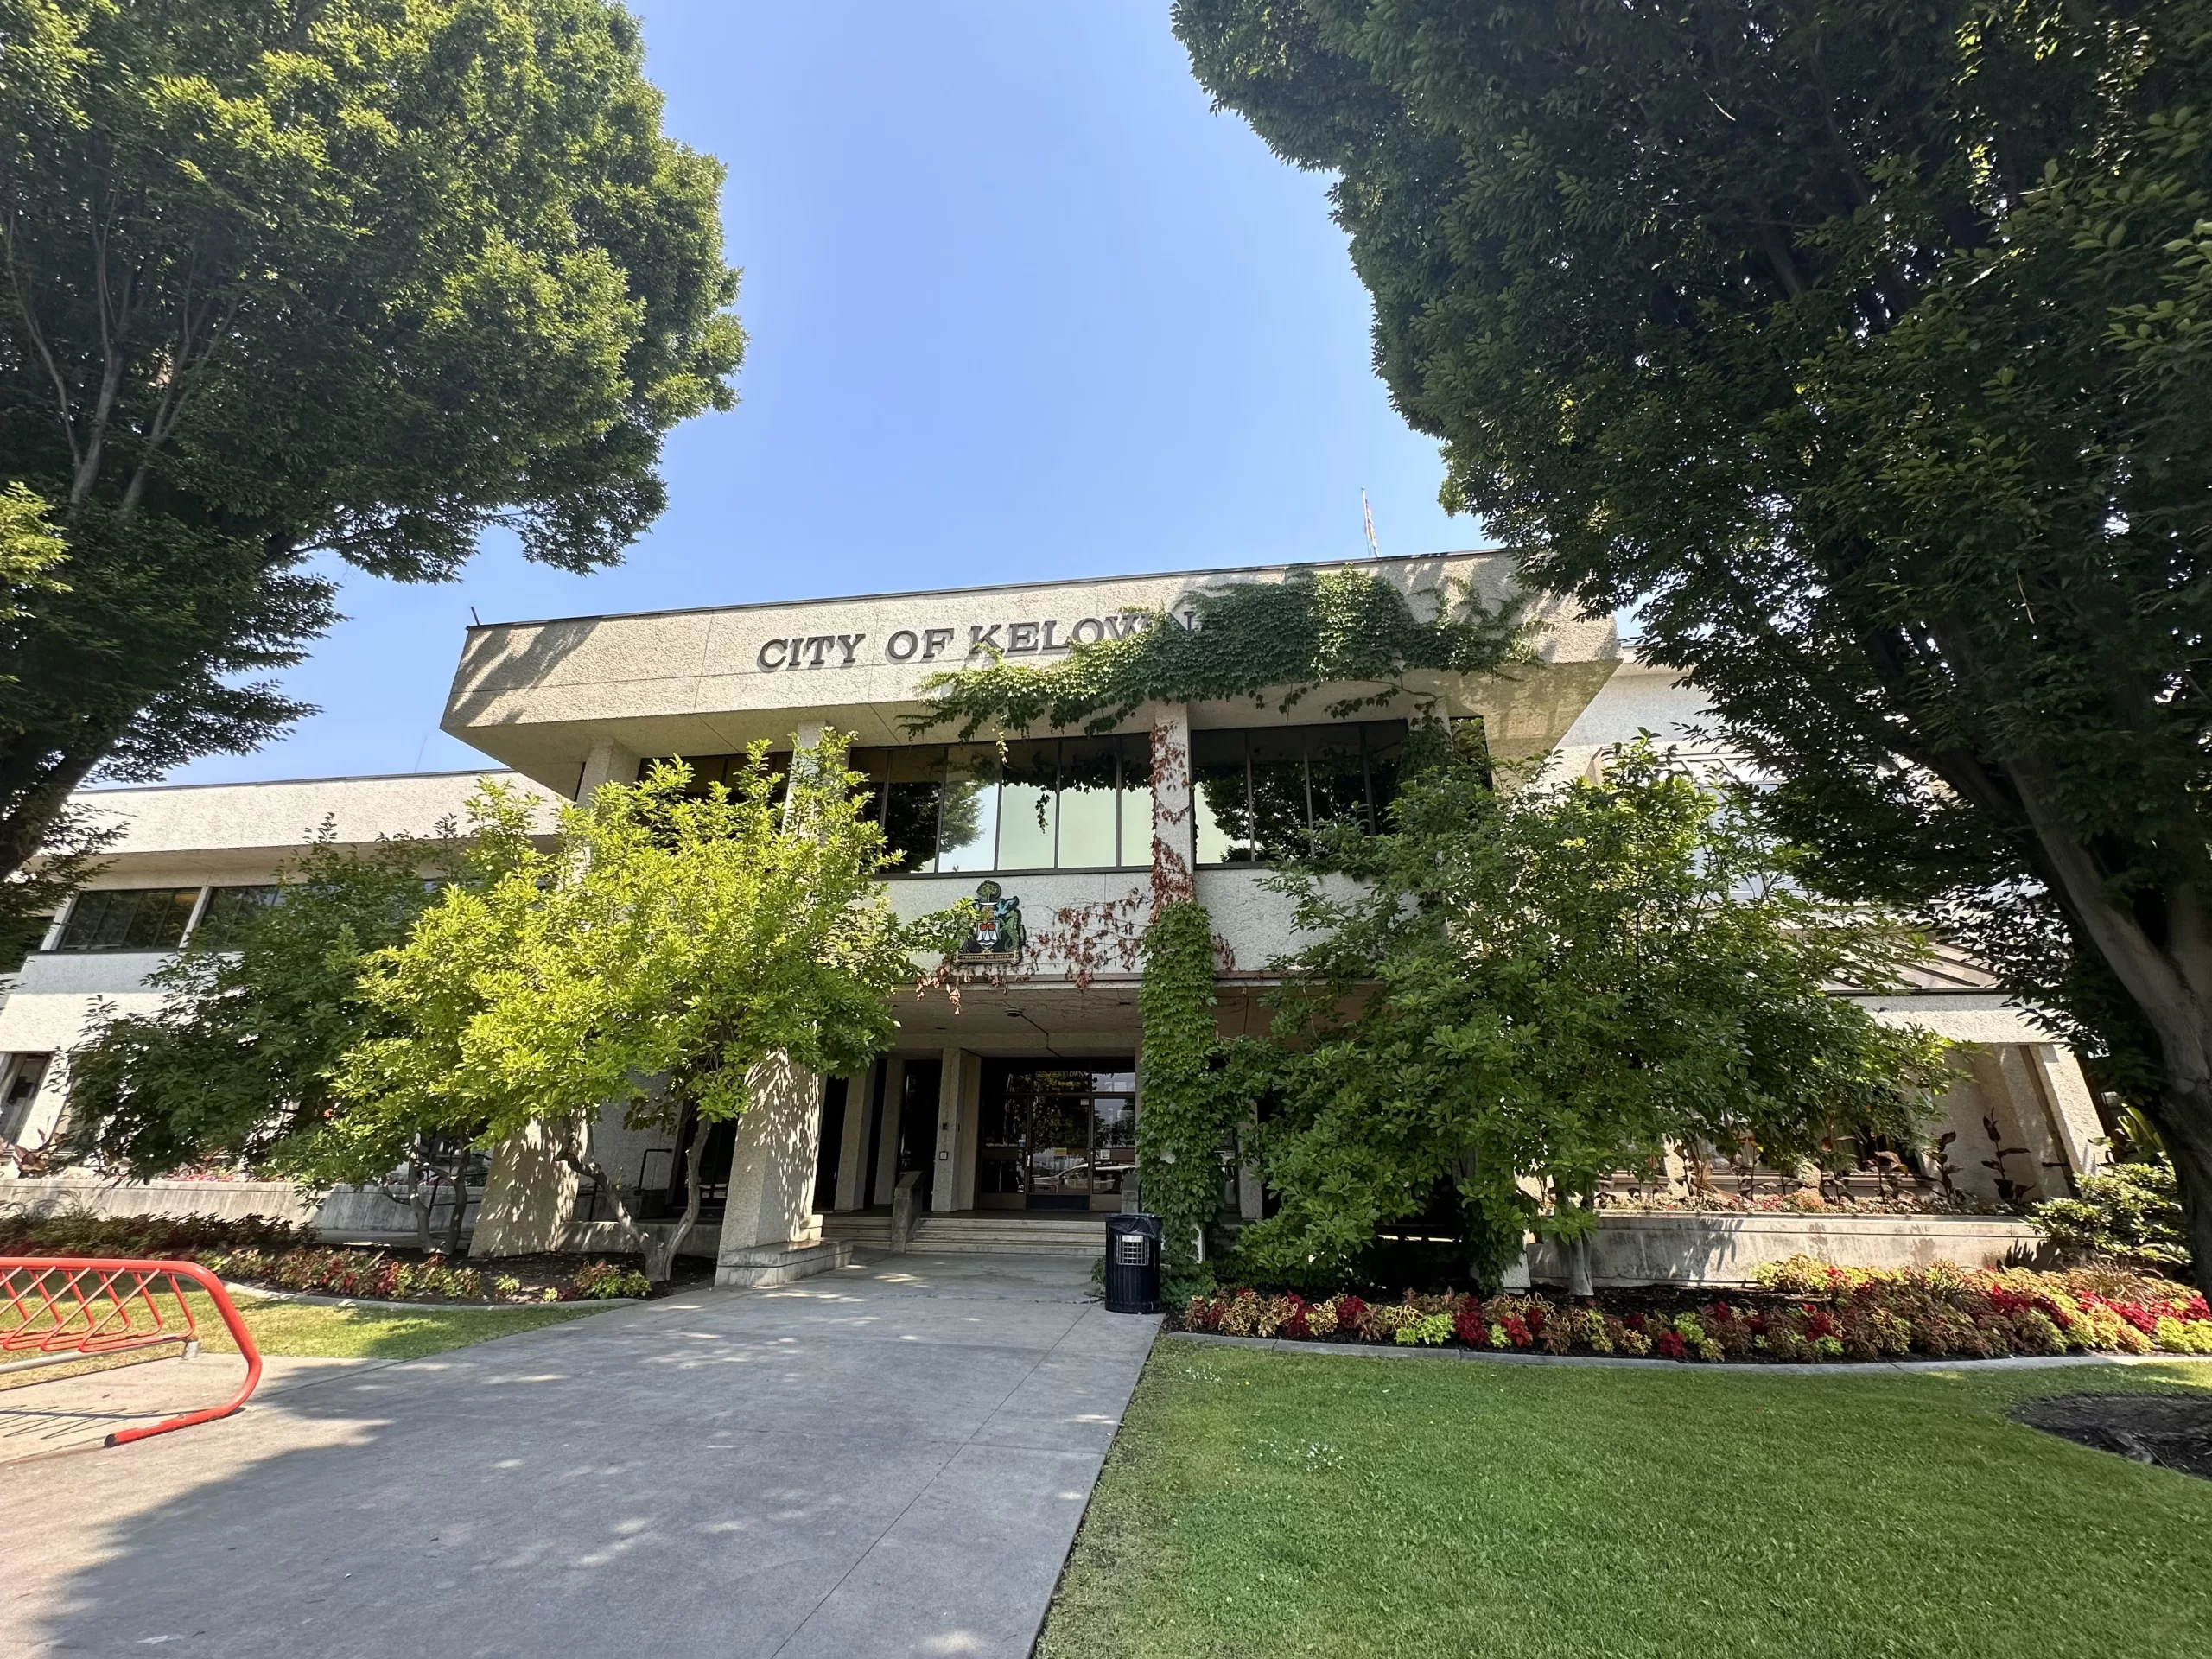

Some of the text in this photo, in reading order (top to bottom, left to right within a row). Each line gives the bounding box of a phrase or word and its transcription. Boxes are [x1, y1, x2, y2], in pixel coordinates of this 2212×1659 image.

[760, 611, 1196, 667] CITY OF KELOWN
